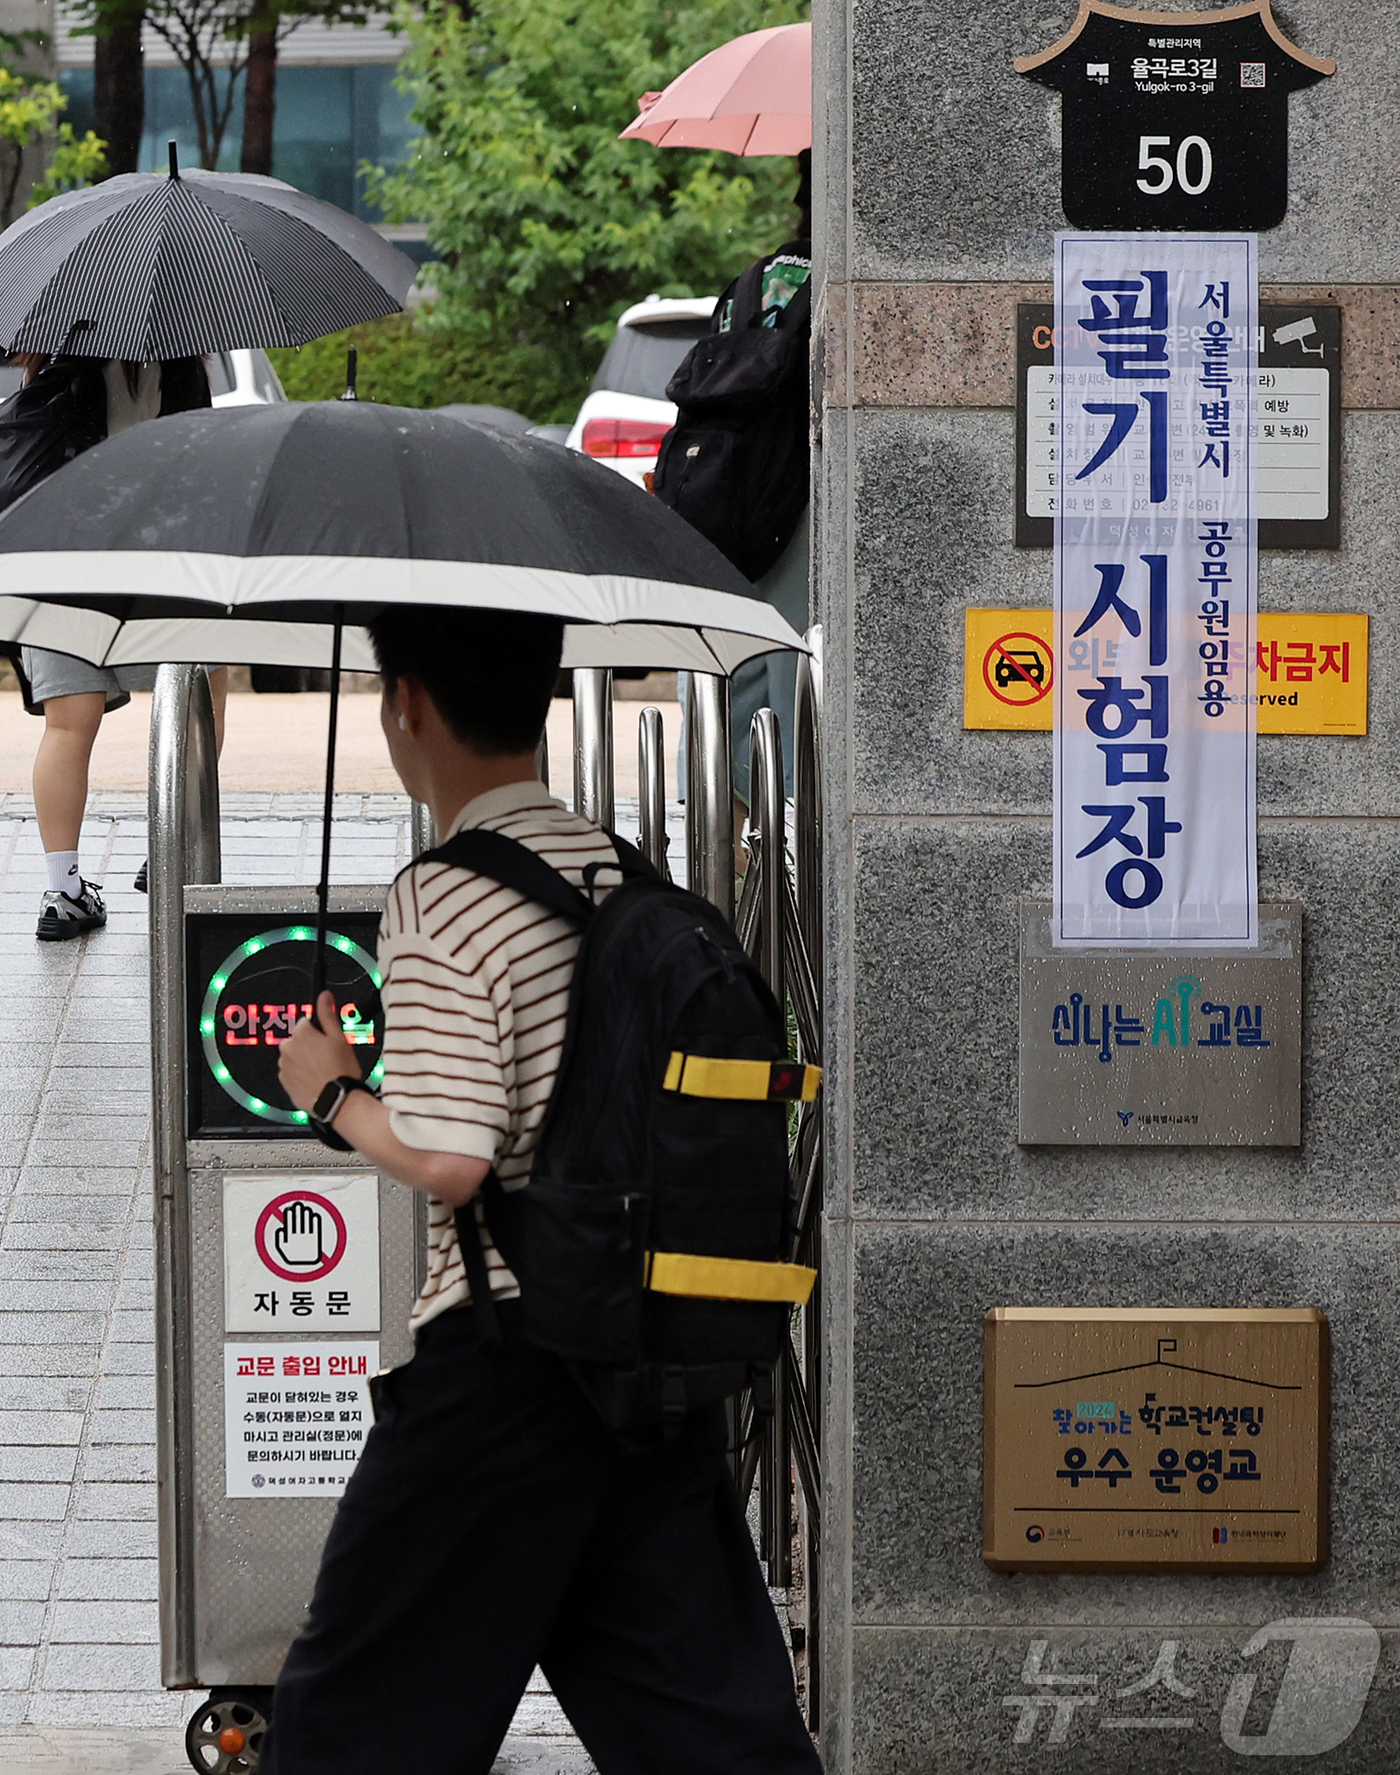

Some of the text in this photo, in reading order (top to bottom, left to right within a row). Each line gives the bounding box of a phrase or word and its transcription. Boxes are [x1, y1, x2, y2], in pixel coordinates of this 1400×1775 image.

[1148, 38, 1202, 49] 특별관리지역
[1130, 58, 1218, 79] 율곡로3길
[1135, 81, 1215, 95] Yulgok-ro 3-gil
[1136, 135, 1213, 196] 50
[1197, 280, 1234, 478] 서울특별시
[1264, 400, 1290, 413] 예방
[1264, 425, 1275, 438] 및
[1279, 425, 1309, 438] 녹화)
[1197, 521, 1234, 718] 공무원임용
[1052, 980, 1271, 1063] 신나는 AI 교실
[236, 1355, 368, 1376] 교문 출입 안내
[246, 1392, 281, 1404] 교문이
[335, 1391, 359, 1403] 경우
[243, 1411, 363, 1423] 수동(자동문)으로 열지
[1138, 1399, 1264, 1437] 학교컨설팅
[244, 1430, 363, 1443] 마시고 관리실(정문)에
[247, 1450, 361, 1463] 문의하시기 바랍니다.
[1056, 1447, 1262, 1494] 우수 운영교
